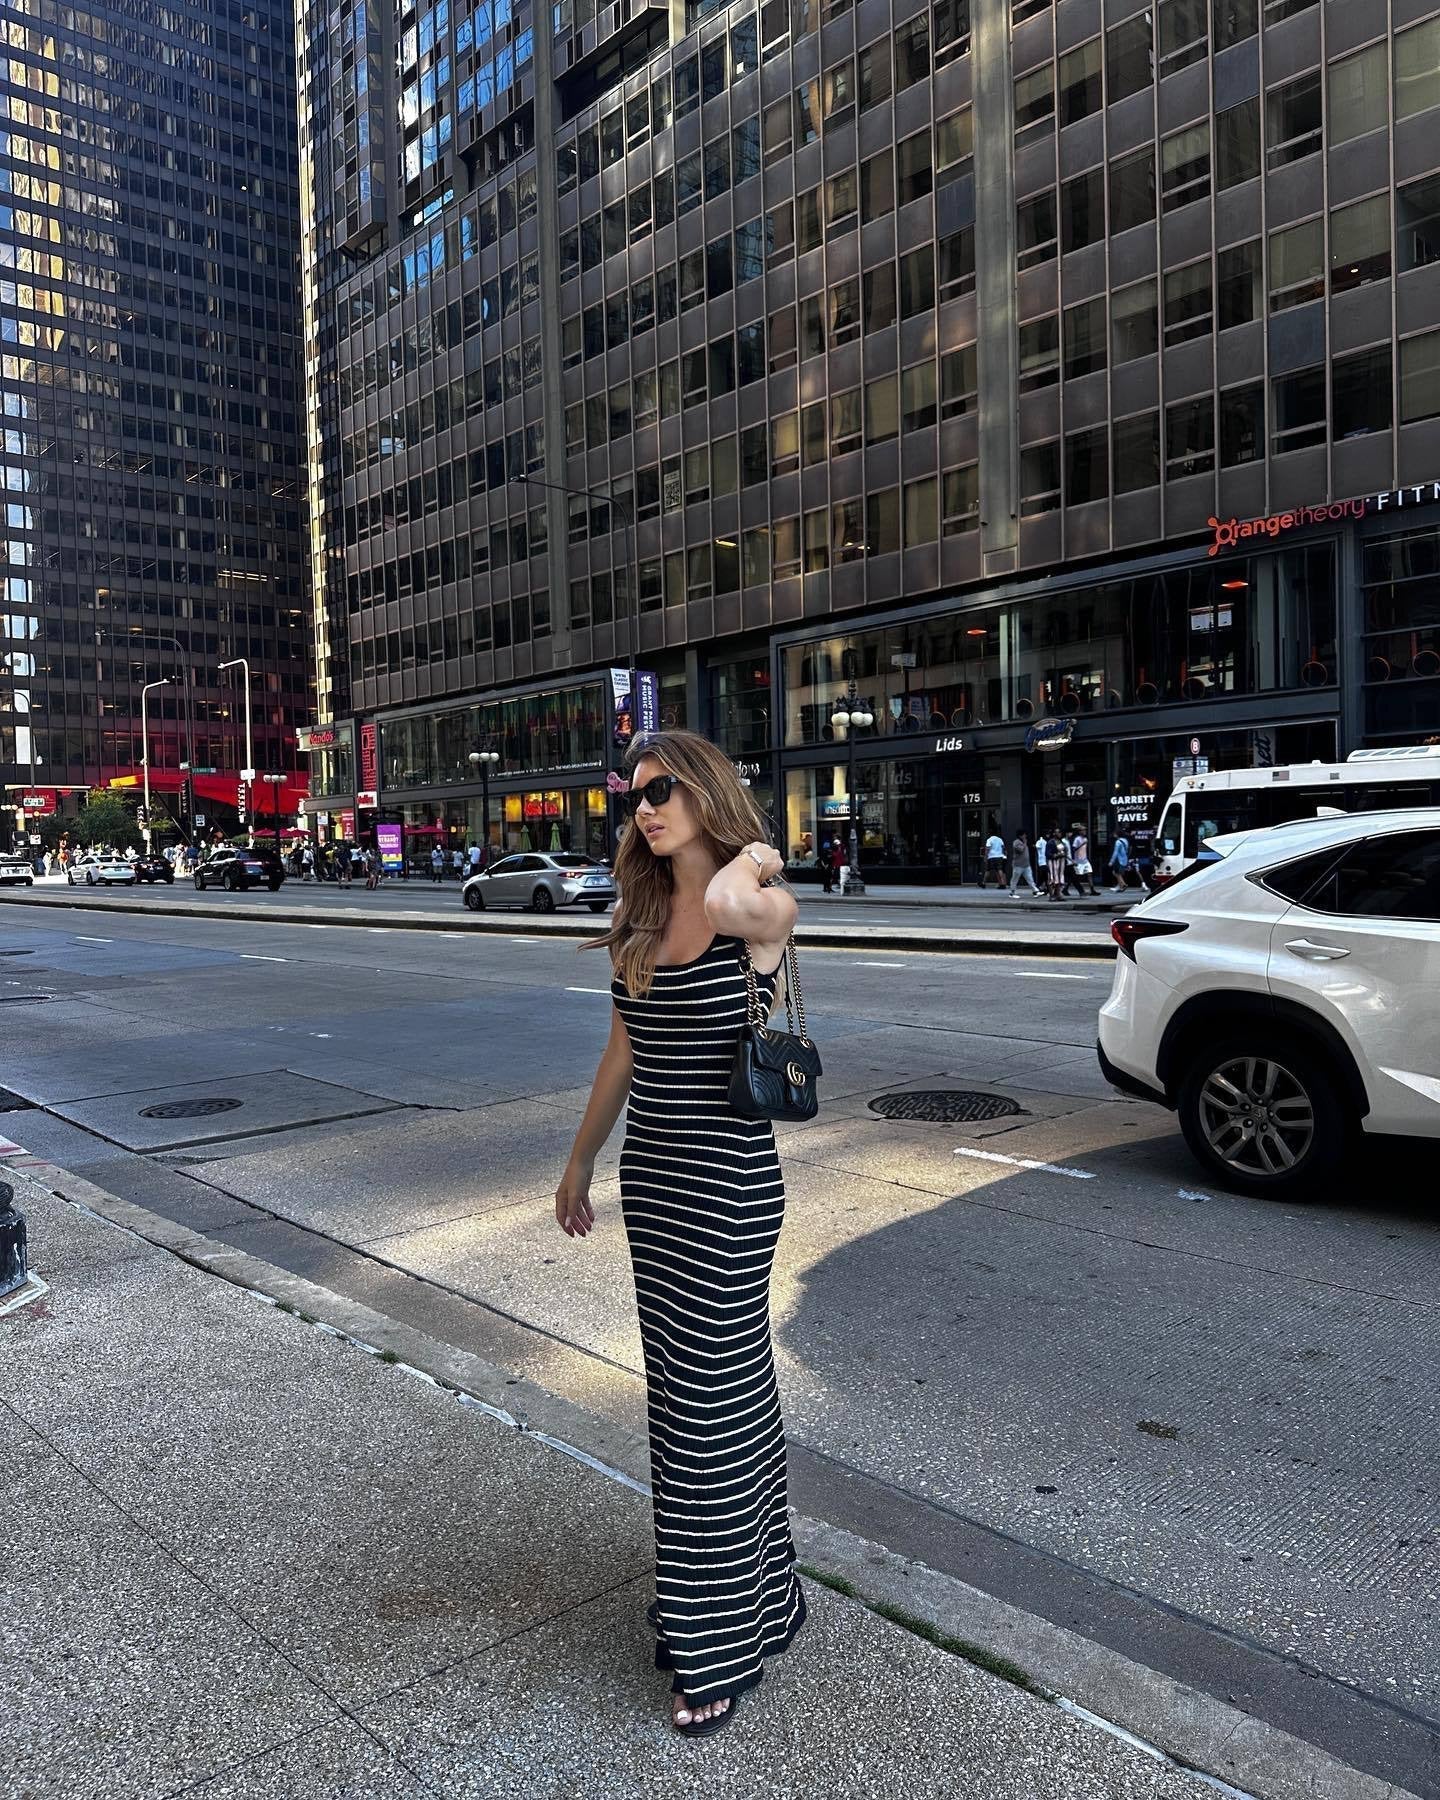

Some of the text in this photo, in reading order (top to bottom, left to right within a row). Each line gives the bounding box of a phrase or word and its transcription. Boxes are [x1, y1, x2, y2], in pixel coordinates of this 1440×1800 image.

[936, 737, 963, 752] Lids
[1065, 786, 1084, 796] 173
[963, 793, 981, 804] 175
[1110, 794, 1156, 805] GARRETT
[1117, 812, 1149, 822] FAVES
